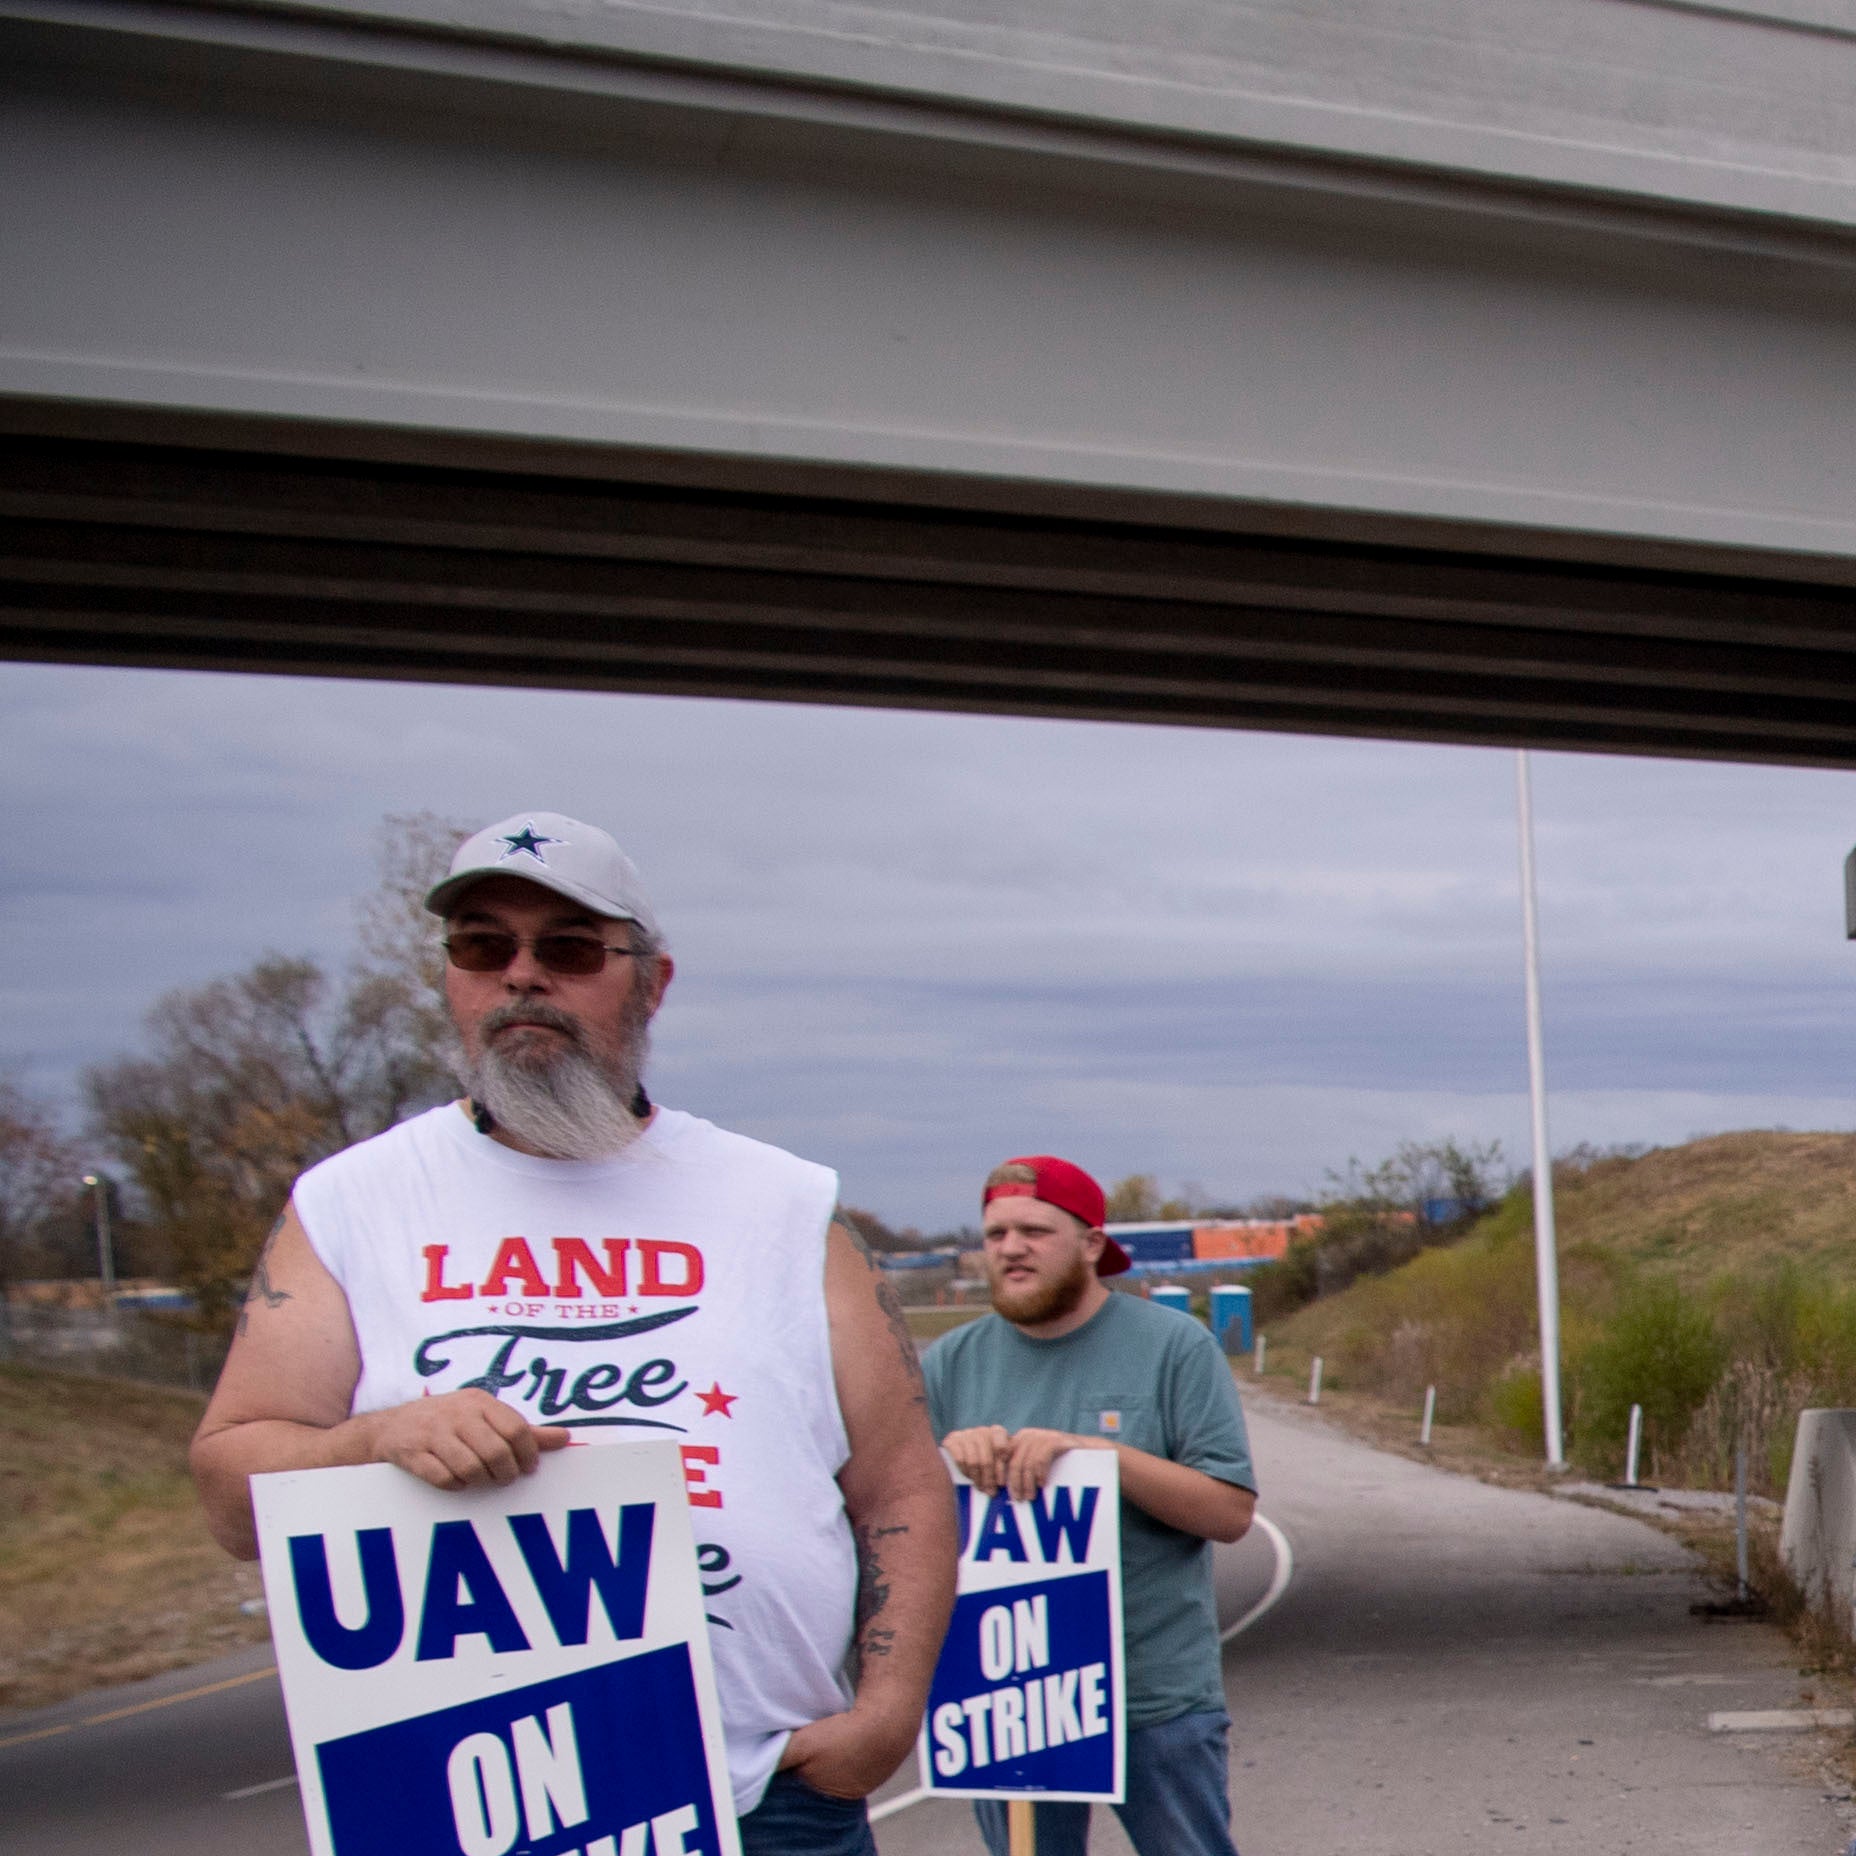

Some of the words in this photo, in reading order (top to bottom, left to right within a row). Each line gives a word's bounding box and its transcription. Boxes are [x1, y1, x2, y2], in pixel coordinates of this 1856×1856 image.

[420, 1236, 705, 1303] LAND
[504, 1302, 545, 1317] OF
[554, 1303, 620, 1319] THE
[413, 1305, 700, 1416] Free
[957, 1485, 1101, 1563] AW
[288, 1502, 656, 1671] UAW
[979, 1594, 1050, 1682] ON
[932, 1661, 1109, 1777] STRIKE
